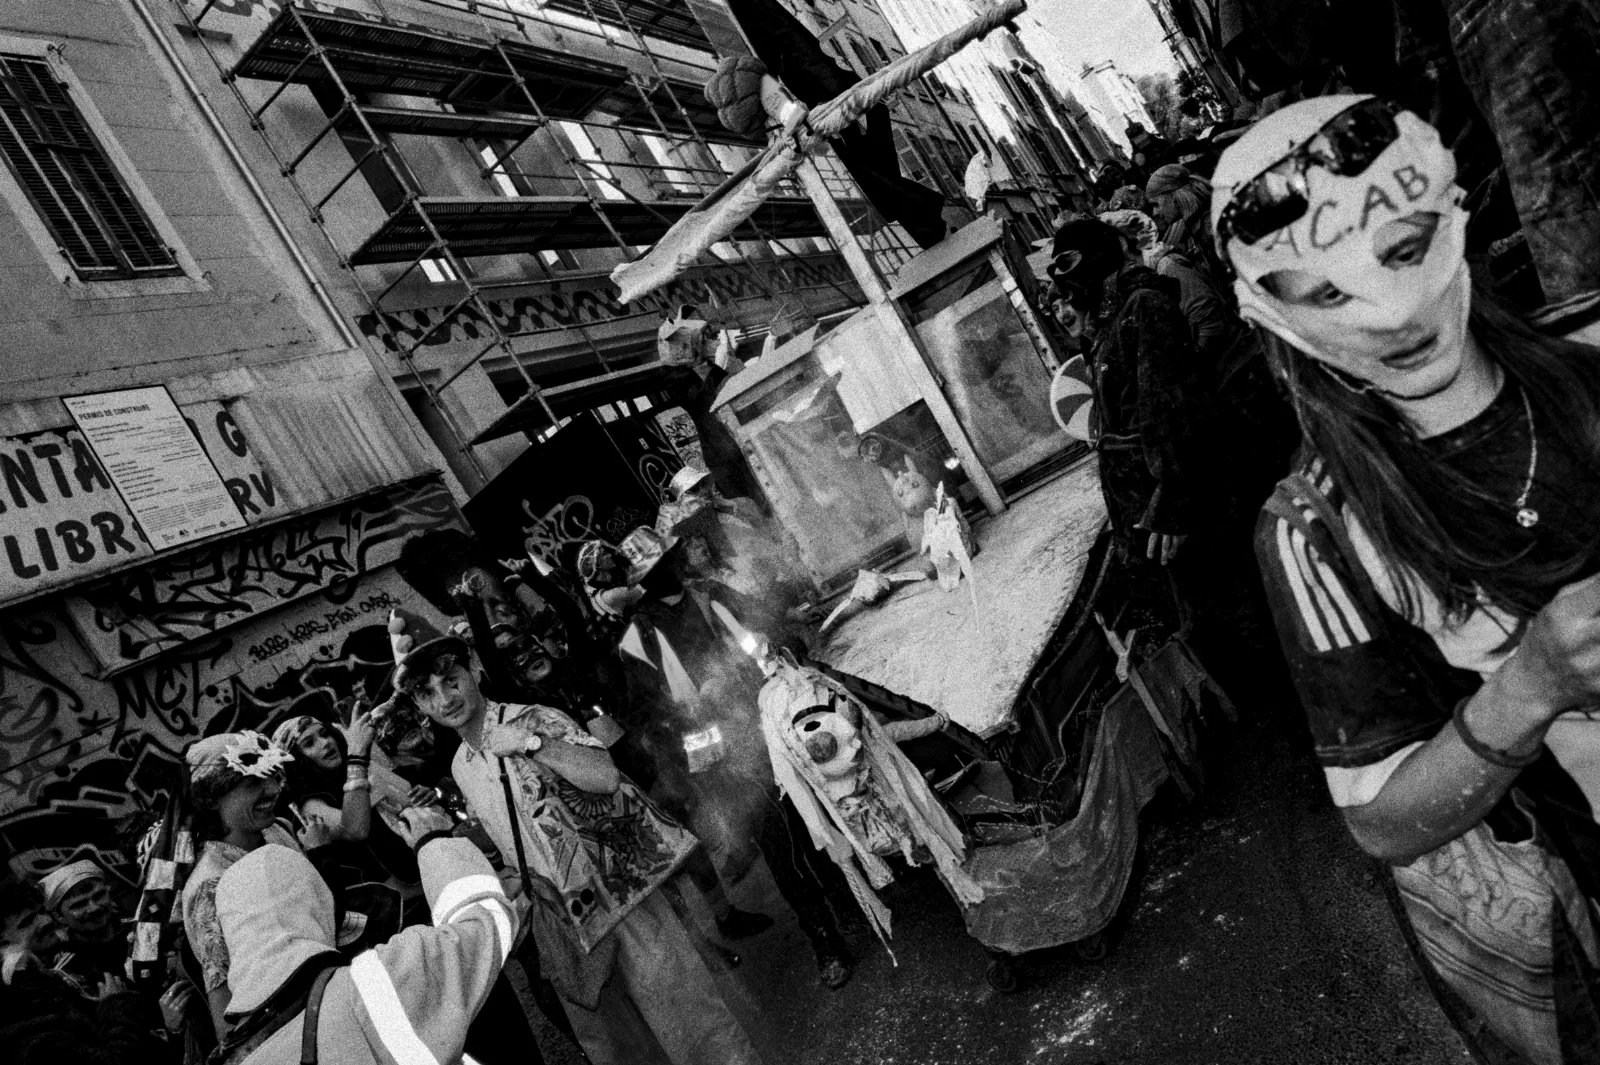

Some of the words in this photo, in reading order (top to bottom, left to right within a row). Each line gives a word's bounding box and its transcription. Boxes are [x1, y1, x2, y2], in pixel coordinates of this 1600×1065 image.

[1264, 165, 1430, 257] ACAB
[78, 410, 104, 421] PERMIS
[113, 403, 152, 416] CONSTRUIRE
[0, 438, 111, 514] NTA
[3, 510, 148, 579] LIBR
